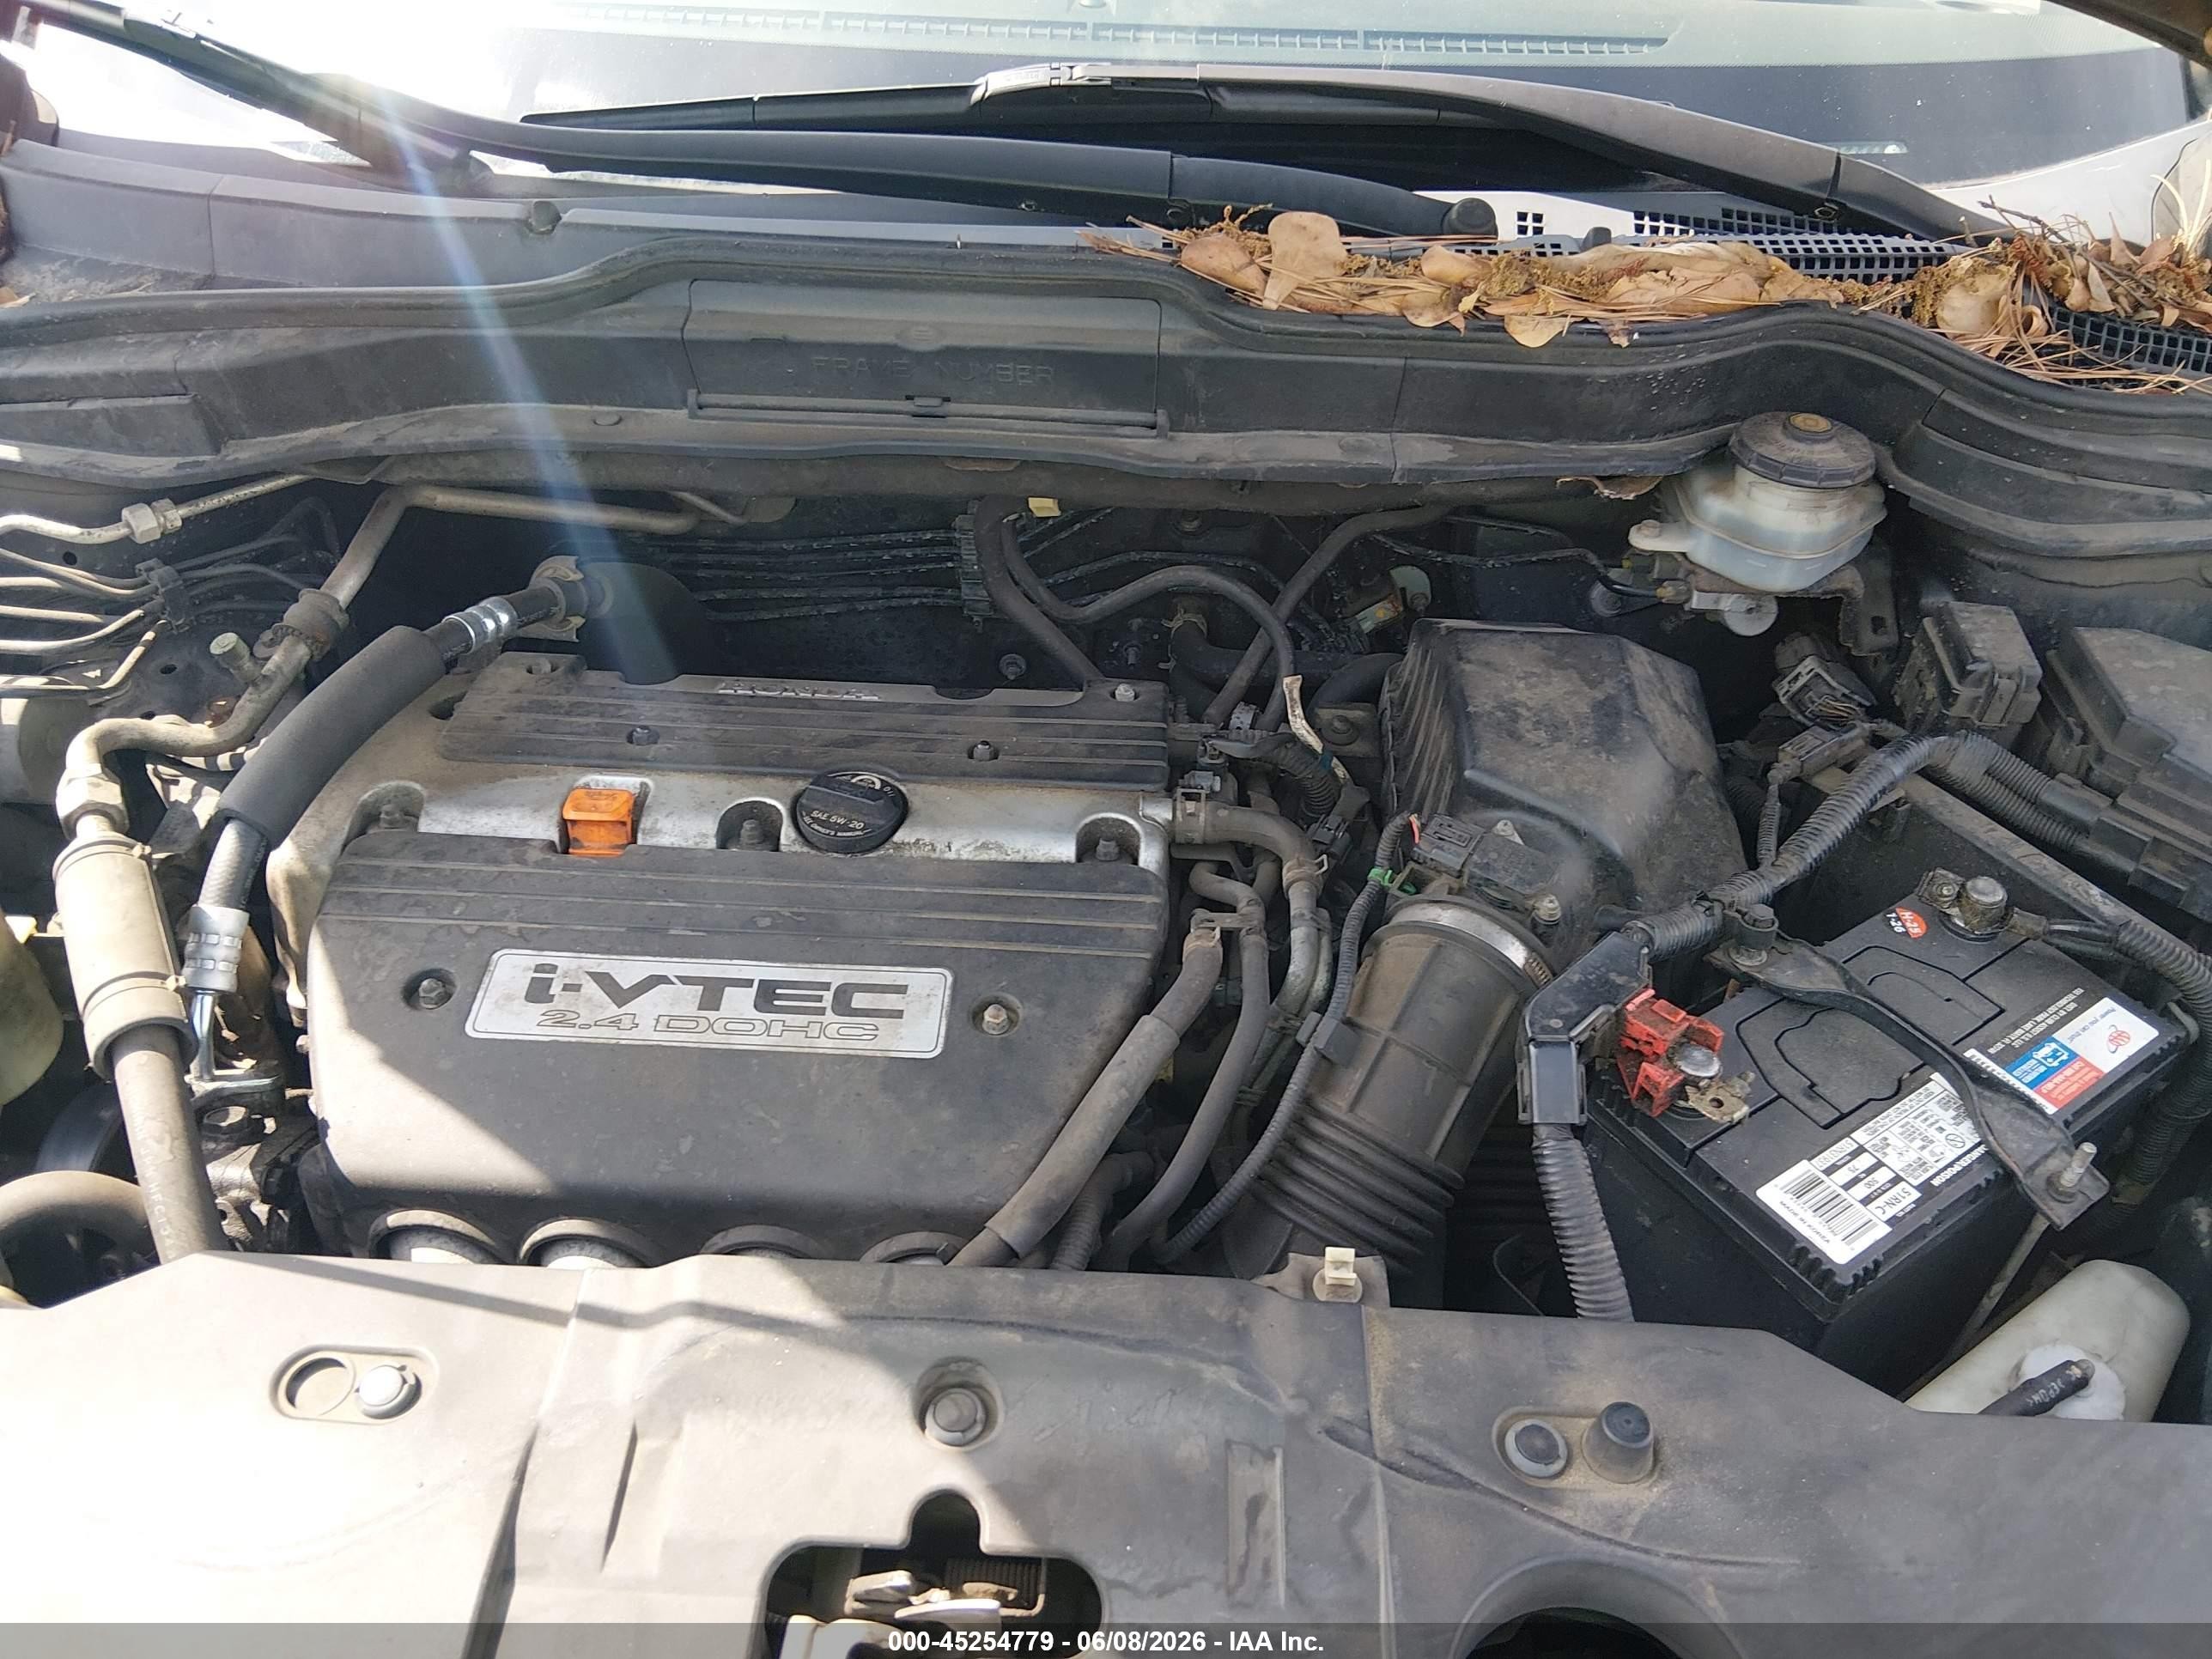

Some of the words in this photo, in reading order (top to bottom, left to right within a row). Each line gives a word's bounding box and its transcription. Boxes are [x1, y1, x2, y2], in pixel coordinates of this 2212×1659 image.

[811, 356, 914, 378] FRAME
[934, 361, 1055, 385] NUMBER
[810, 810, 830, 821] SAE
[829, 813, 866, 830] 5W-20
[523, 963, 908, 1020] i-VTEC
[537, 1008, 640, 1031] 2.4
[653, 1014, 880, 1042] DOHC
[1863, 1177, 1879, 1189] 500
[1875, 1188, 1911, 1214] 51RN-C
